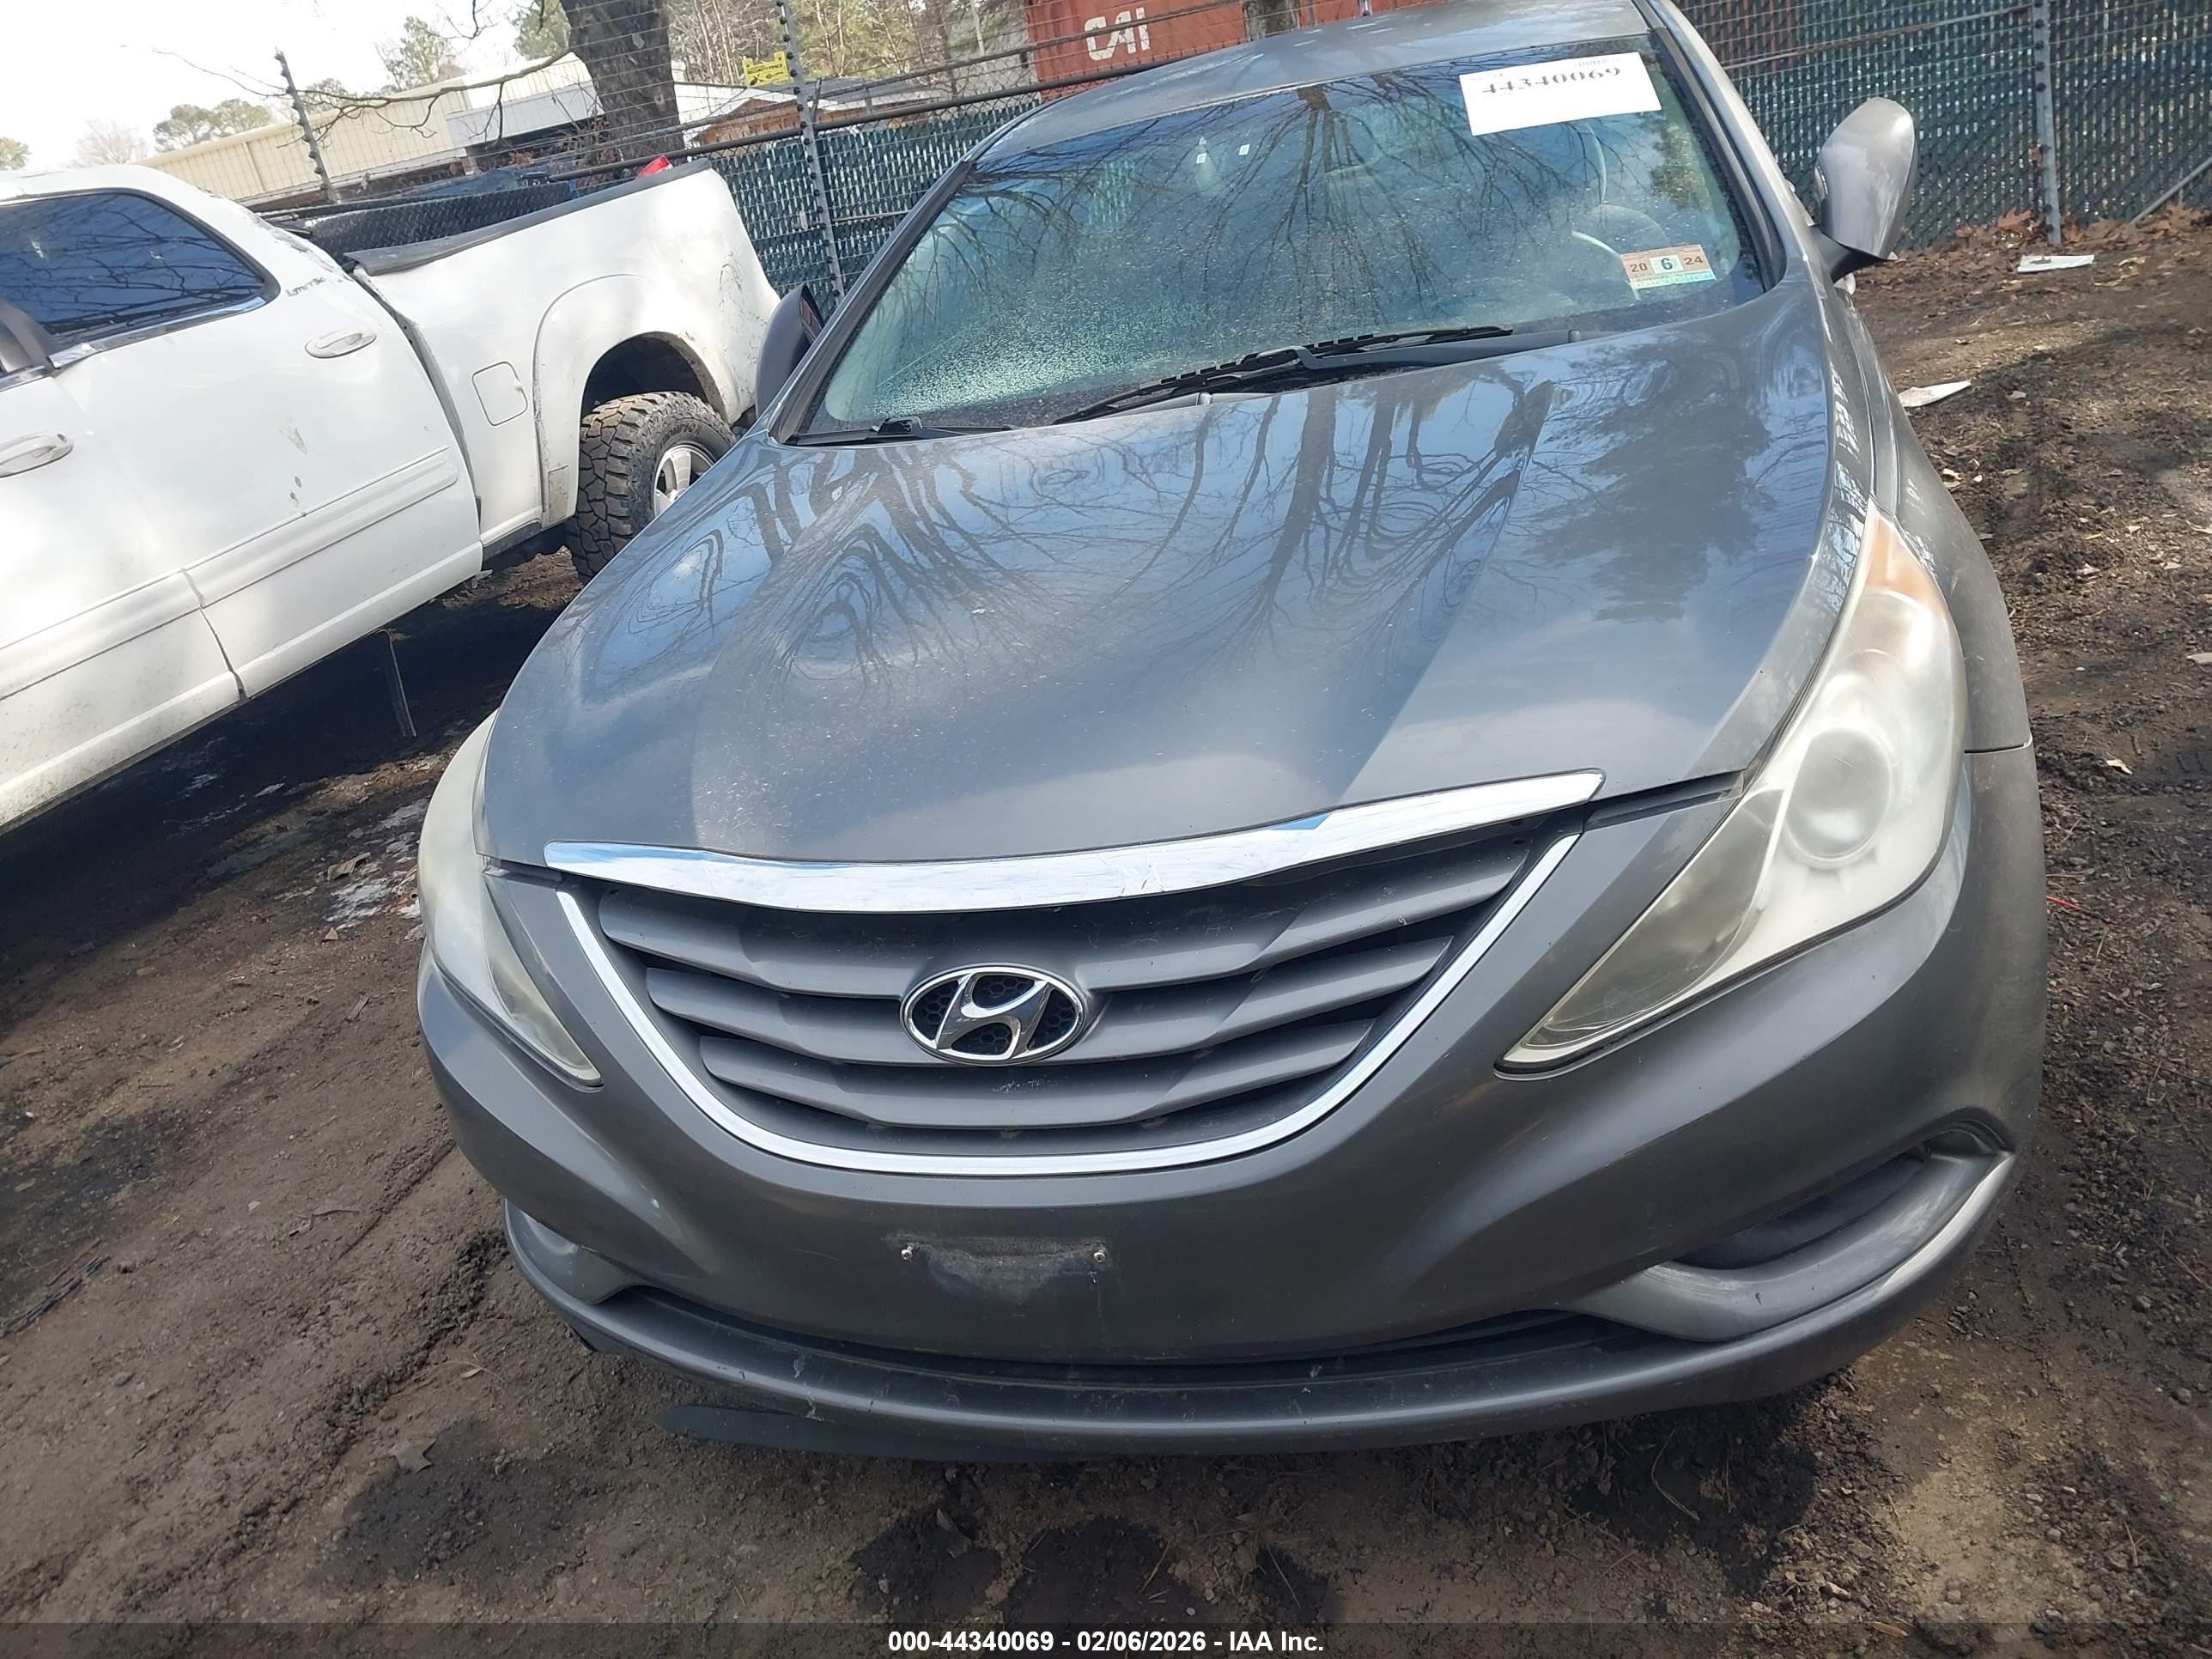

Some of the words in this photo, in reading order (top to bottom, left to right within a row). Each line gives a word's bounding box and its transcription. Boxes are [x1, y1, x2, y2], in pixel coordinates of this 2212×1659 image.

[1483, 67, 1621, 94] 44340069
[1630, 263, 1648, 273] 20
[1660, 258, 1674, 270] 6
[1684, 256, 1704, 266] 24
